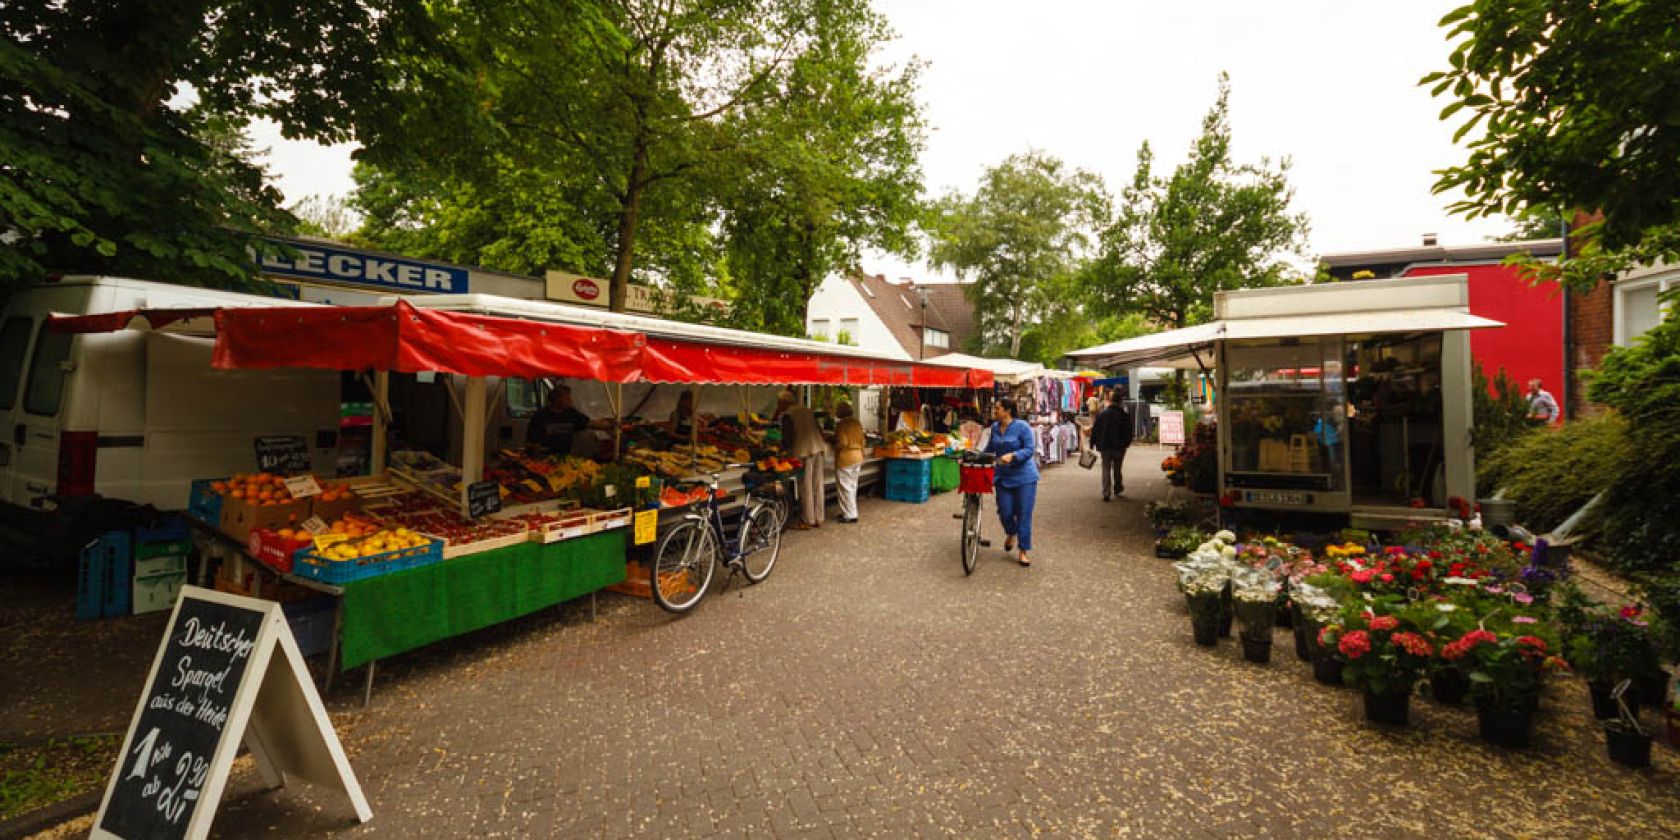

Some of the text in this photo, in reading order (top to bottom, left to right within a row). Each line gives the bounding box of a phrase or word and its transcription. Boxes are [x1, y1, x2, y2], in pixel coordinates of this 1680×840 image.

[172, 655, 232, 698] Spargel
[150, 693, 228, 731] aus der Heide
[125, 727, 160, 781] 1
[142, 774, 161, 798] ab
